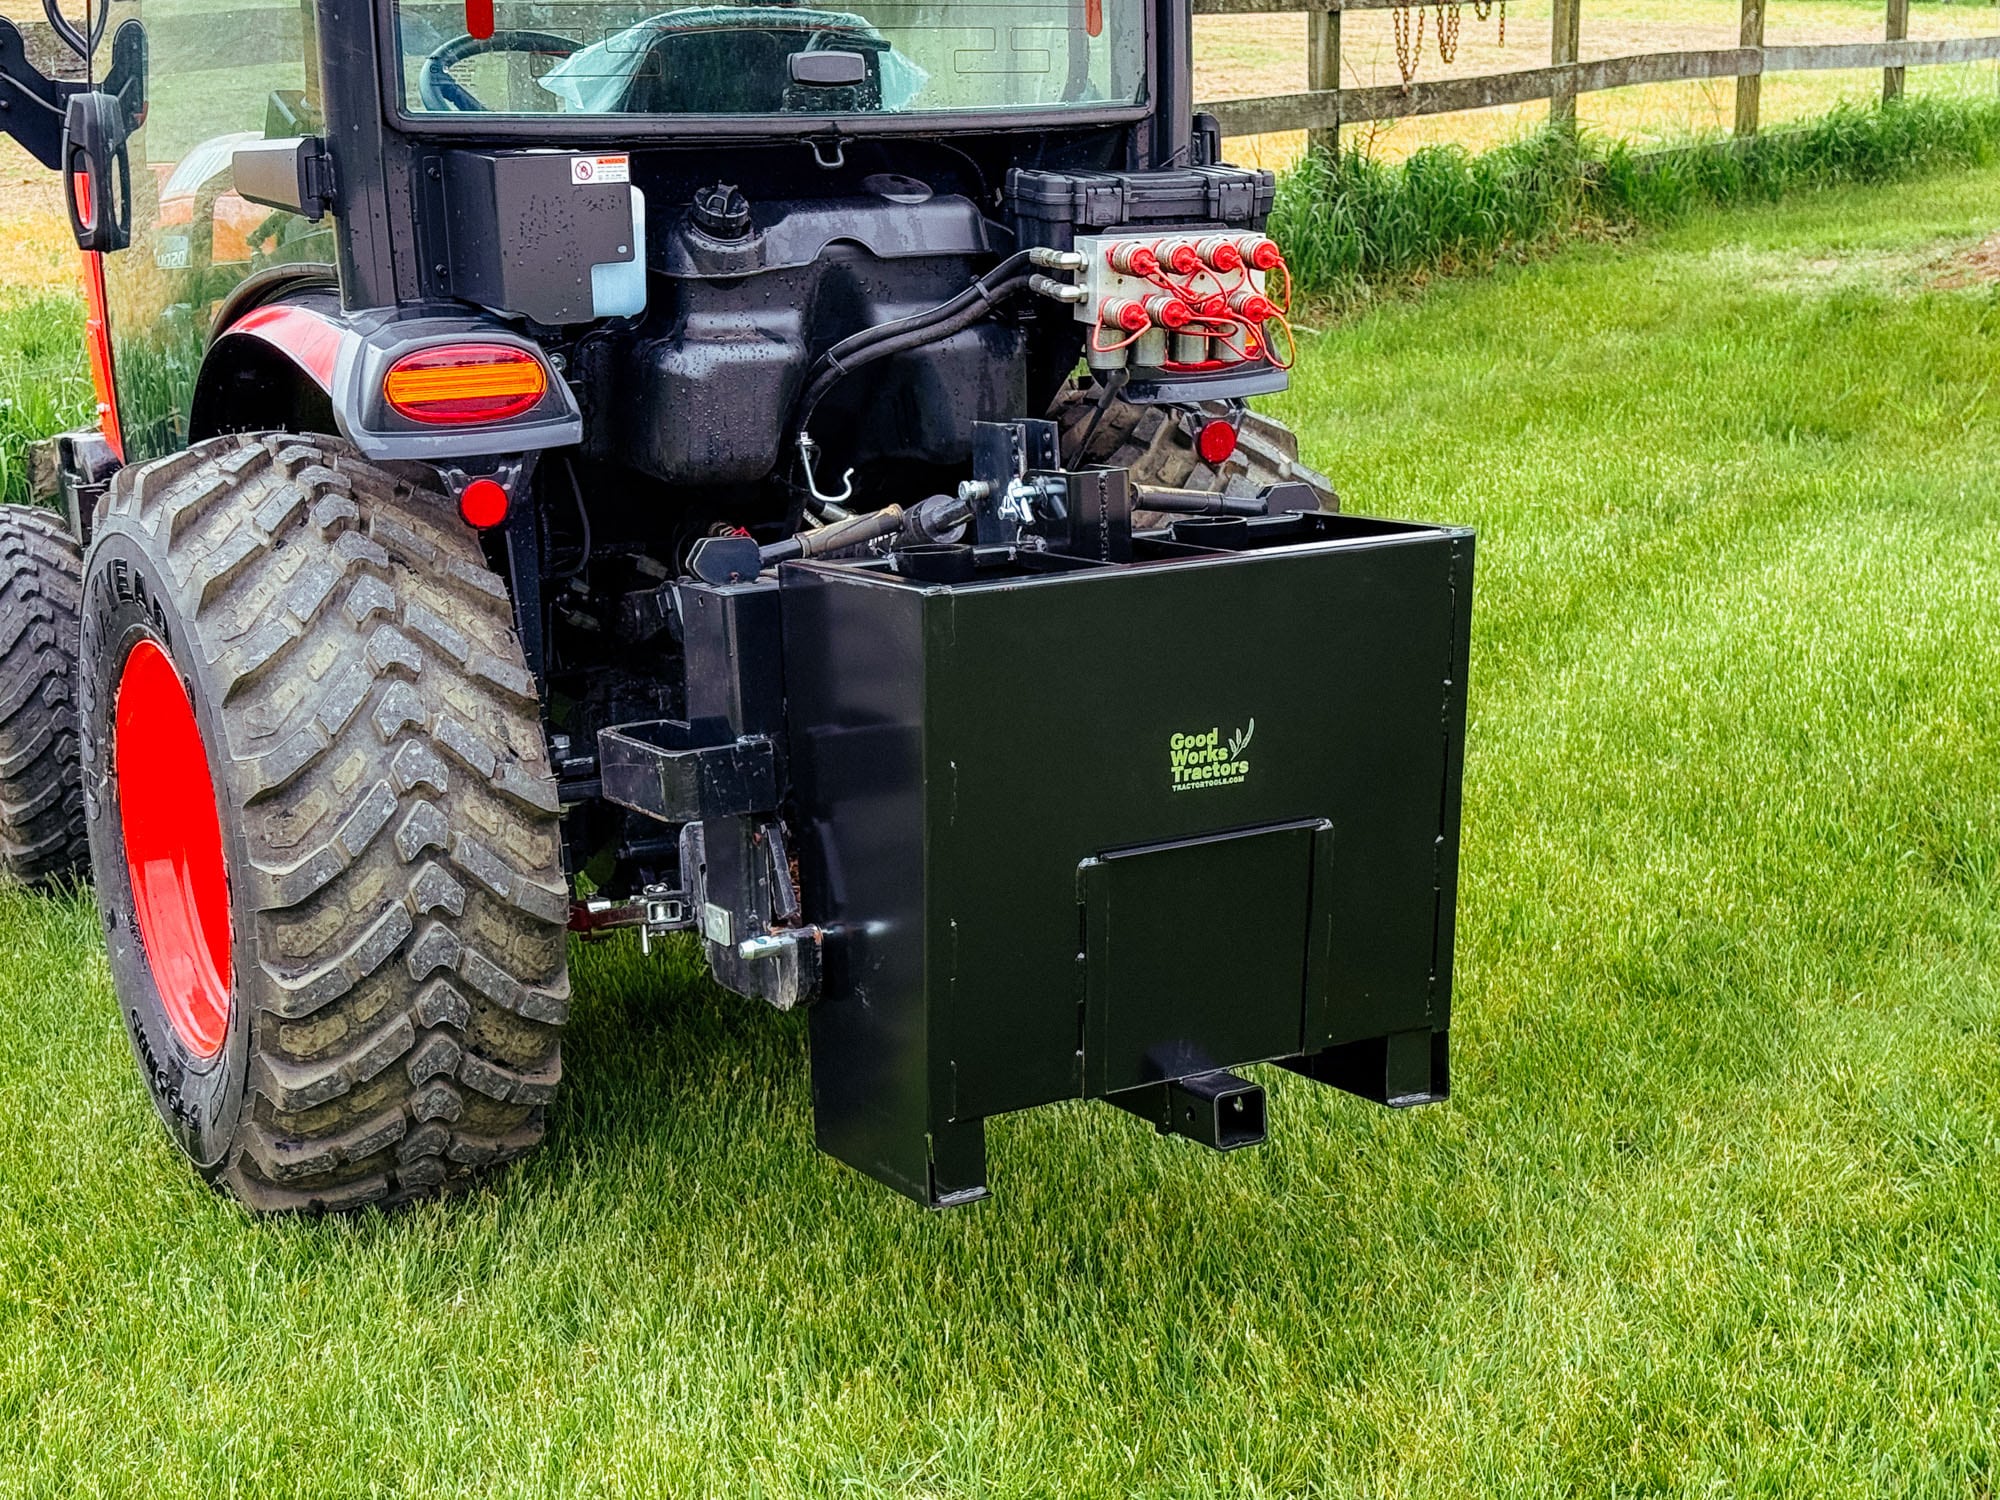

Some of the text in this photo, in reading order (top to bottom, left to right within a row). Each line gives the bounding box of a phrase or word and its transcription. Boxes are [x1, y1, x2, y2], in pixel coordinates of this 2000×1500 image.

[81, 557, 175, 820] GOODYEAR
[1170, 727, 1218, 750] Good
[1170, 744, 1228, 766] Works
[1171, 760, 1249, 783] Tractors
[1172, 775, 1245, 792] TRACTORTOOLS.COM
